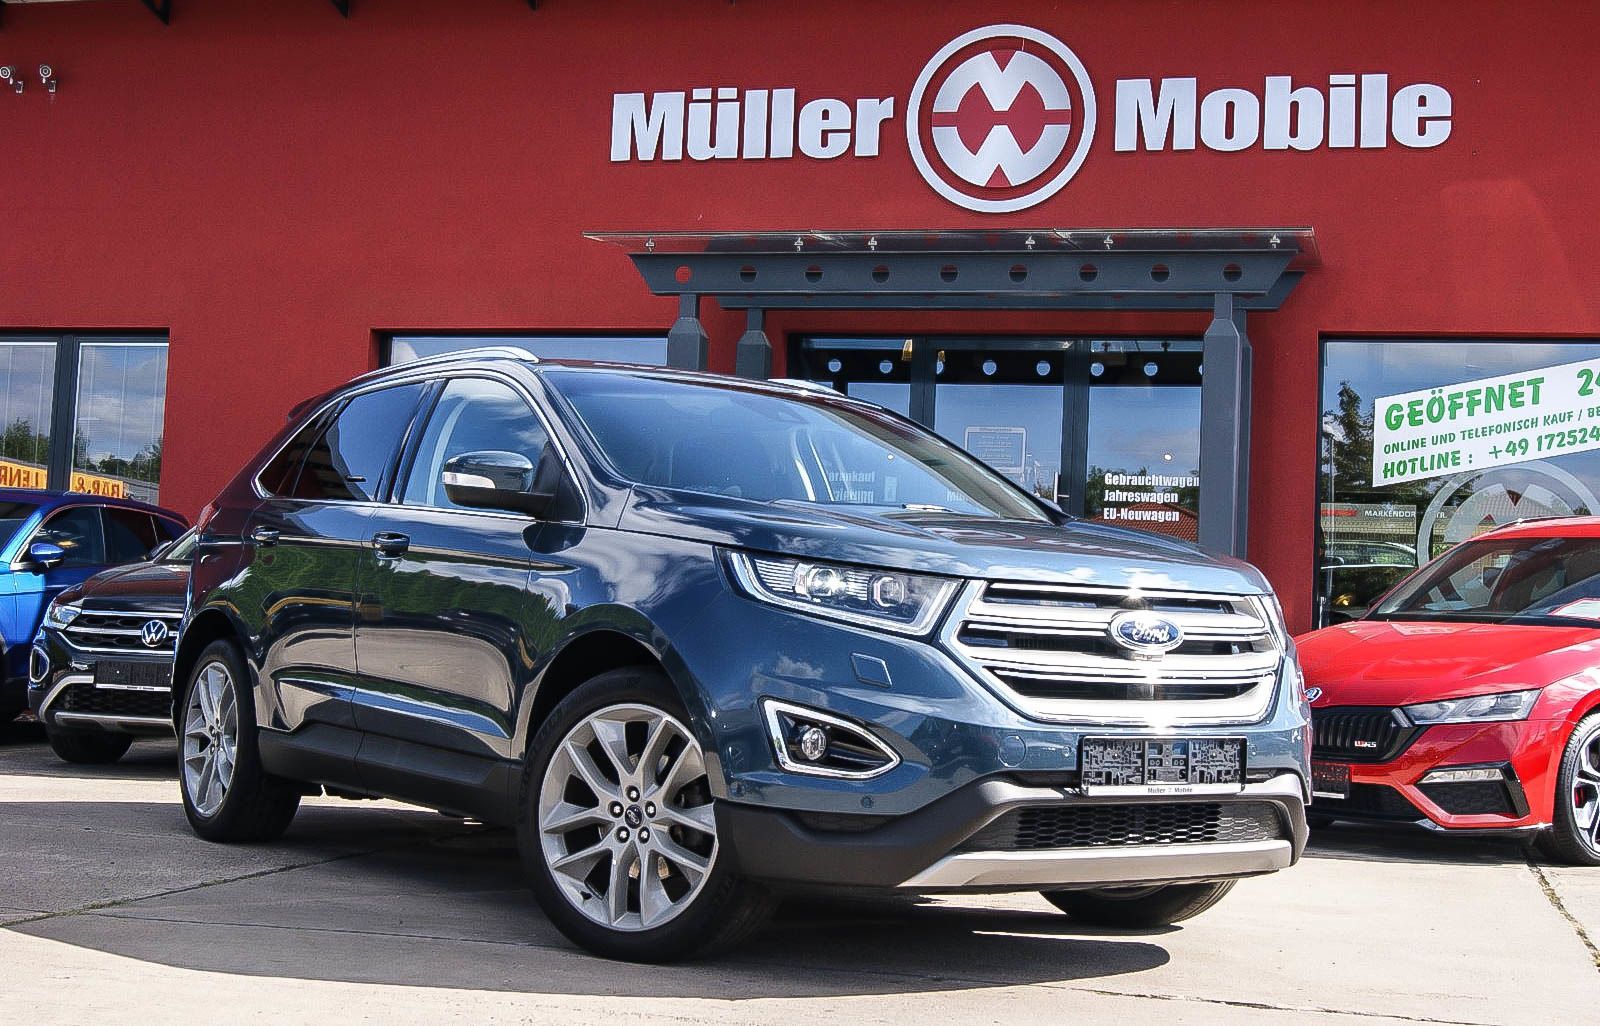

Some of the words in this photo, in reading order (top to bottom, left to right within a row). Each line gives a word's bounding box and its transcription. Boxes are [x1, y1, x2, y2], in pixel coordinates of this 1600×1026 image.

[610, 87, 895, 162] Müller
[1114, 73, 1453, 152] Mobile
[1384, 377, 1545, 431] GEÖFFNET
[1383, 438, 1427, 455] ONLINE
[1431, 432, 1456, 446] UND
[1460, 417, 1539, 441] TELEFONISCH
[1543, 410, 1574, 427] KAUF
[1383, 450, 1461, 479] HOTLINE
[1488, 438, 1530, 460] +49
[1537, 426, 1600, 452] 172524
[1103, 490, 1179, 504] Jahreswagen
[1104, 472, 1199, 488] Gebrauchtwagen
[1103, 507, 1180, 522] EU-Neuwagen
[1131, 618, 1171, 642] Ford
